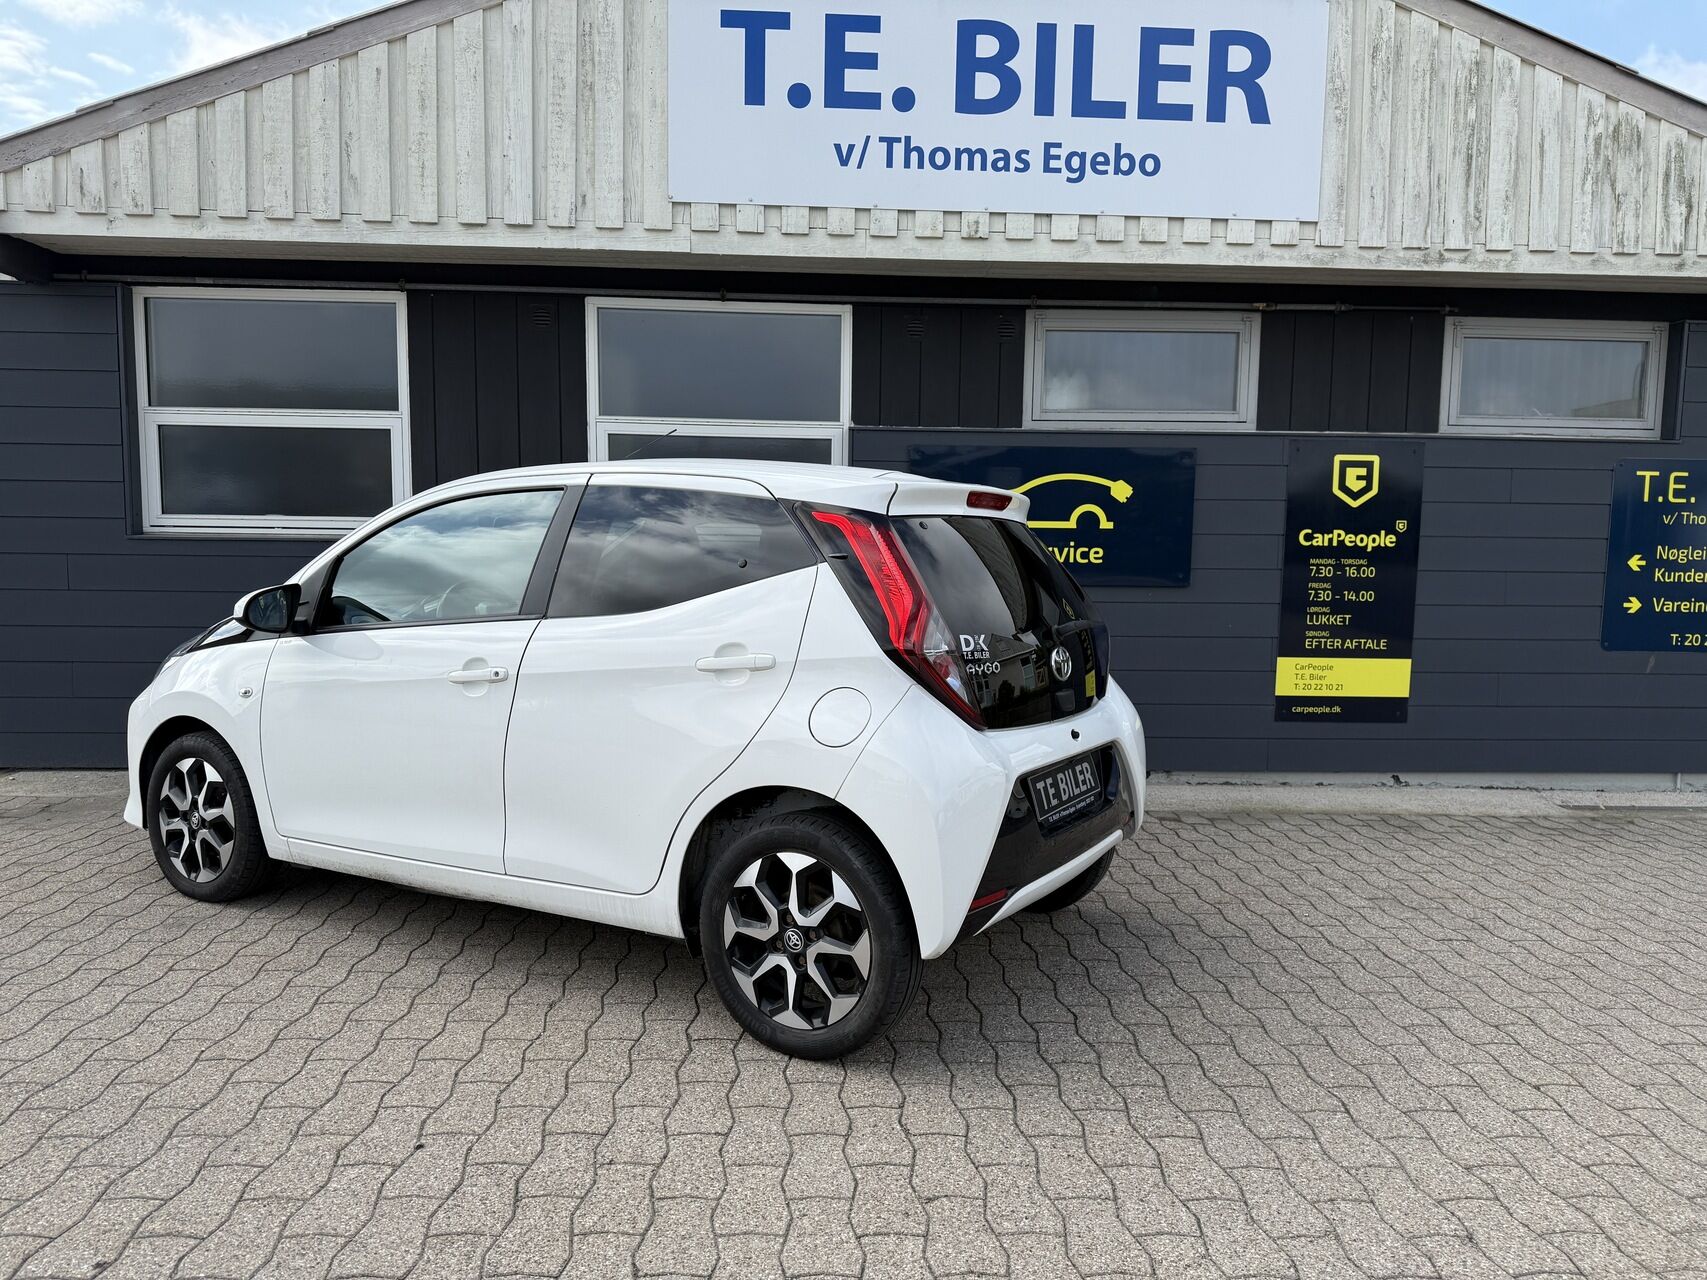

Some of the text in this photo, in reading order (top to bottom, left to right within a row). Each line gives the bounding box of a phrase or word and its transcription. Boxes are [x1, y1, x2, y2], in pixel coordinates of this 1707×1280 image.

[719, 9, 1273, 126] T.E. BILER
[833, 135, 1162, 184] v/ Thomas Egebo
[1635, 470, 1696, 503] T.E.
[1662, 512, 1679, 525] v/
[1298, 528, 1397, 552] CarPeople
[1047, 541, 1104, 564] vice
[1309, 566, 1334, 577] 7.30
[1344, 566, 1376, 578] 16.00
[1308, 590, 1332, 601] 7.30
[1343, 590, 1375, 602] 14.00
[1306, 614, 1352, 626] LUKKET
[1305, 638, 1388, 650] EFTER AFTALE
[1670, 633, 1682, 647] T:
[1684, 633, 1701, 647] 20
[962, 651, 991, 660] T.E. BILER
[966, 661, 1001, 675] AYGO
[1294, 663, 1334, 672] CarPeople
[1294, 673, 1327, 681] T.E. Biler
[1294, 683, 1344, 691] T: 20 22 10 21
[1291, 705, 1342, 714] carpeople.dk
[1056, 761, 1096, 802] BILER
